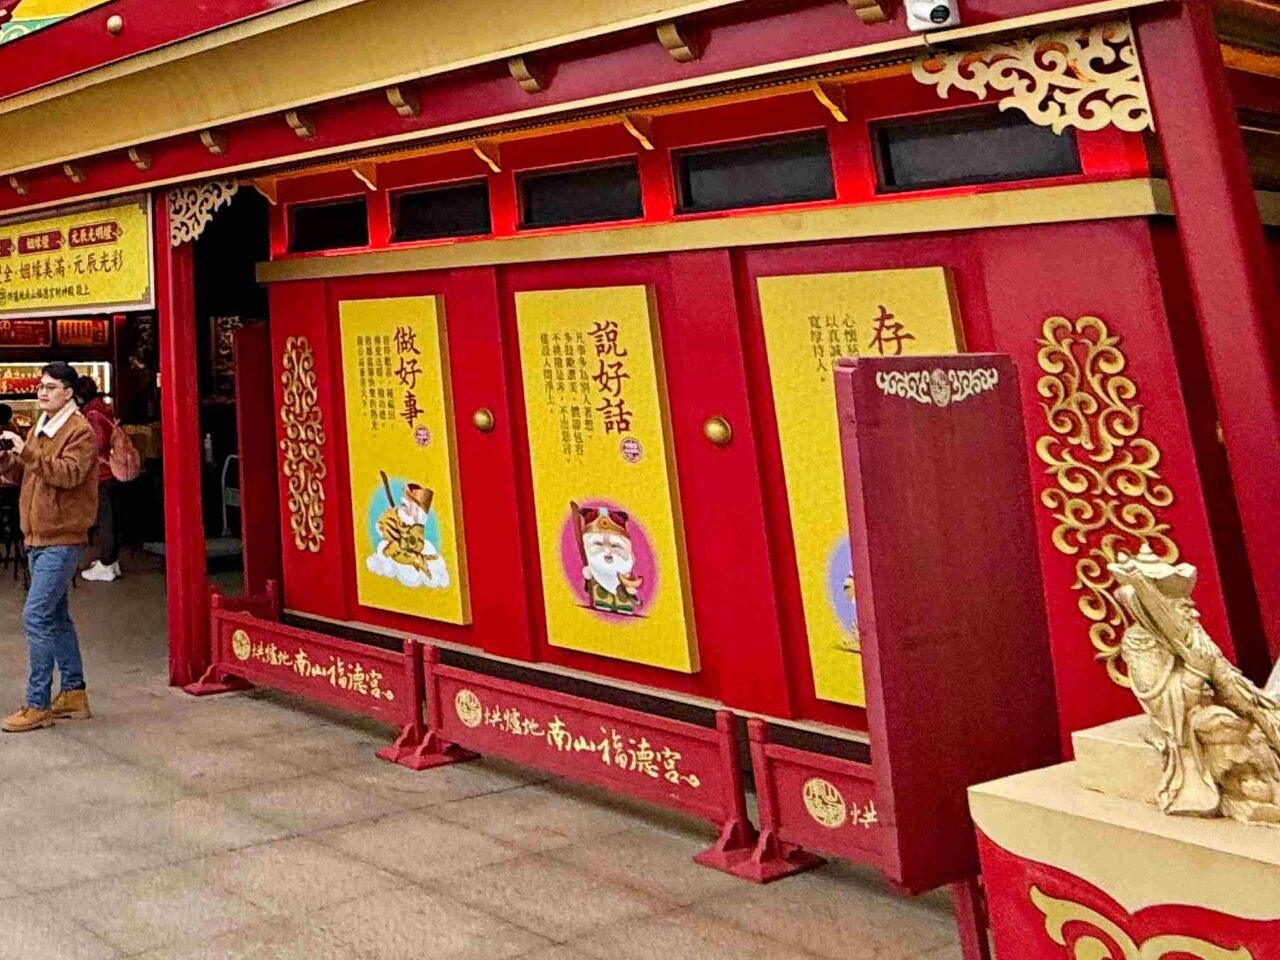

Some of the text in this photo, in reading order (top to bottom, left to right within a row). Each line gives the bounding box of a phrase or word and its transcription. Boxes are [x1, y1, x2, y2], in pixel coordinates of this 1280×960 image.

[393, 326, 425, 428] 做好事
[587, 320, 633, 434] 說好話
[869, 304, 916, 355] 存
